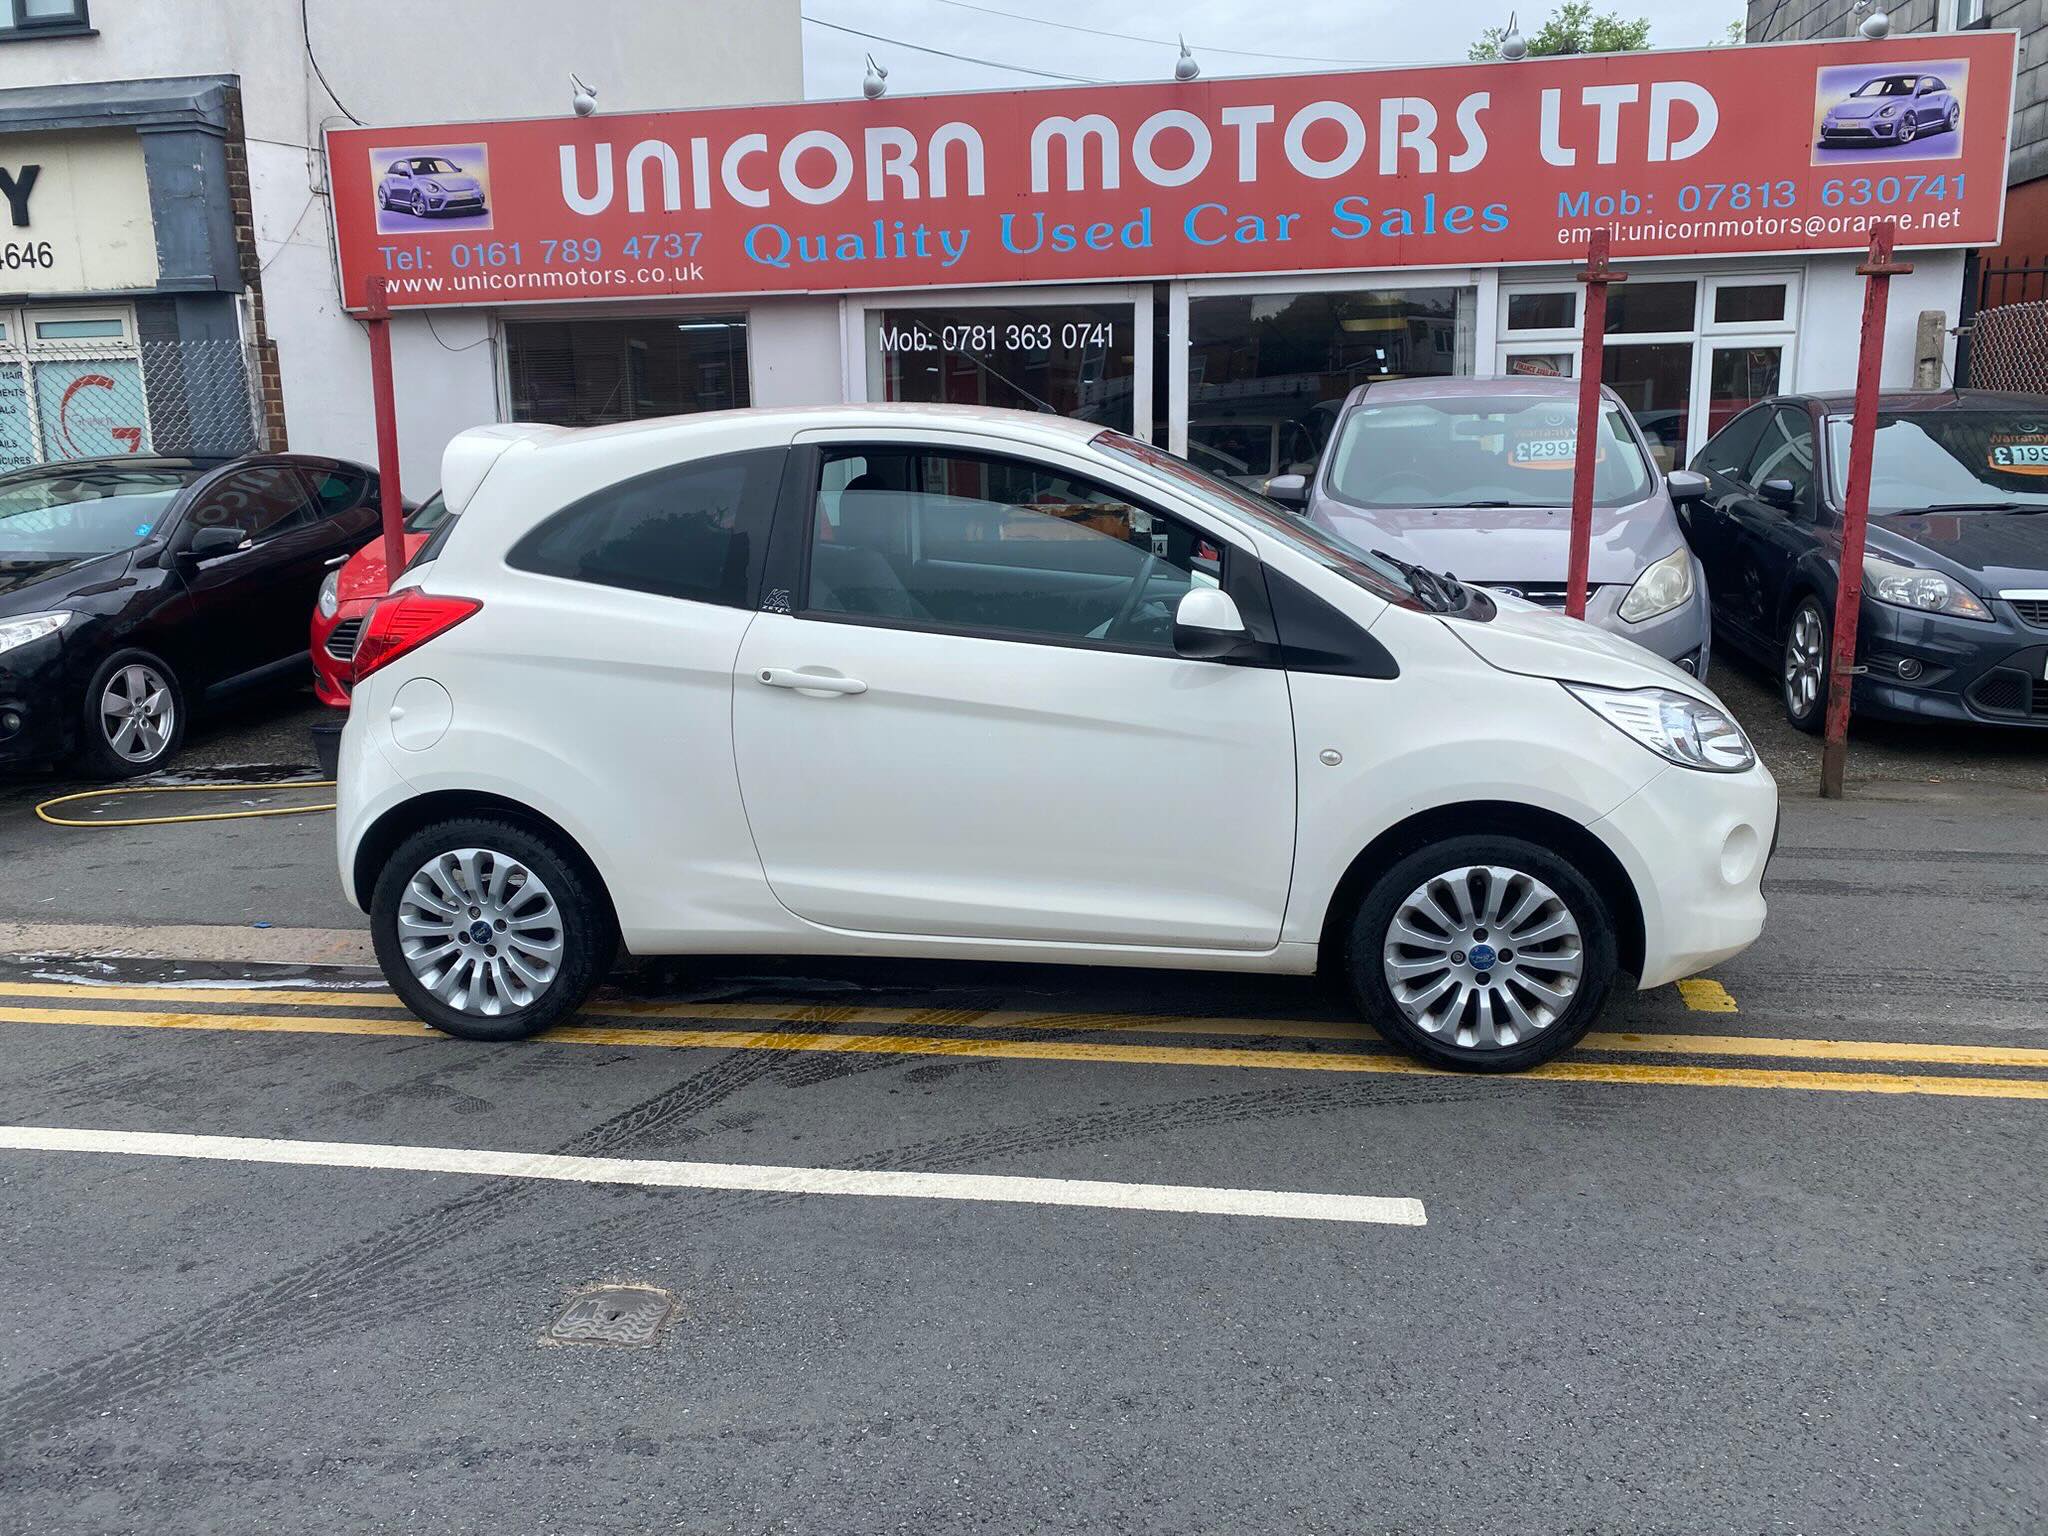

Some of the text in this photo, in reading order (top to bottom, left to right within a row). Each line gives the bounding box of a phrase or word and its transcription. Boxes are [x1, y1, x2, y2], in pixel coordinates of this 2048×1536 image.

[559, 81, 1719, 216] UNICORN MOTORS LTD
[1557, 173, 1967, 218] Mob: 07813 630741
[743, 191, 1510, 269] Quality Used Car Sales
[1557, 207, 1961, 244] emil:unicornmotors@orane.net
[379, 231, 704, 271] Tel: 0161 789 4737
[385, 262, 705, 293] www.unicornmotors.co.uk
[879, 322, 1114, 352] Mob: 0781 363 0741
